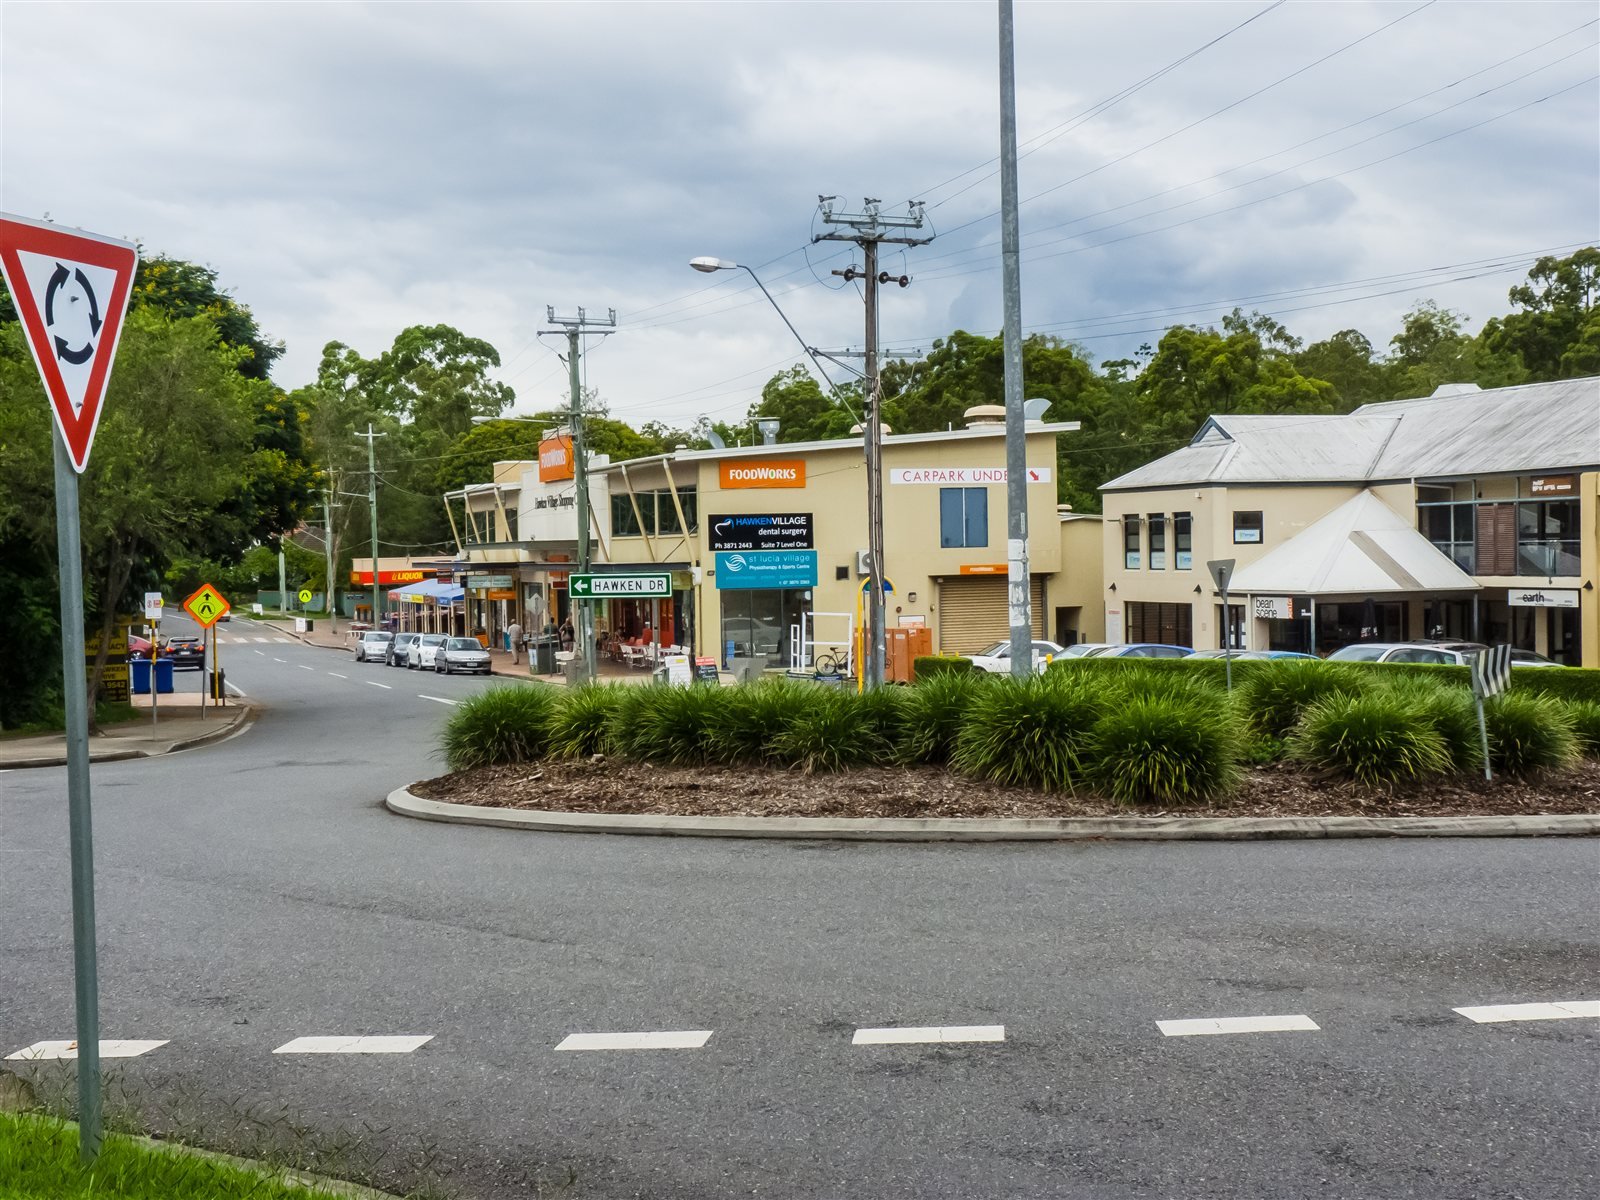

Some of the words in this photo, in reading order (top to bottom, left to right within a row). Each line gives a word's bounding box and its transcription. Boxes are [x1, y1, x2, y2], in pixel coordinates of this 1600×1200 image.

[729, 468, 796, 480] FOODWORKS
[902, 470, 965, 482] CARPARK
[972, 470, 1008, 482] UNDE
[735, 517, 807, 526] HAWKENVILLAGE
[758, 528, 780, 536] dental
[781, 528, 807, 537] surgery
[748, 555, 757, 563] st
[759, 555, 780, 563] lucia
[783, 554, 810, 564] village
[594, 580, 642, 591] HAWKEN
[649, 580, 664, 590] DR
[1522, 591, 1545, 603] earth
[1255, 597, 1274, 609] bean
[1255, 608, 1278, 619] scene
